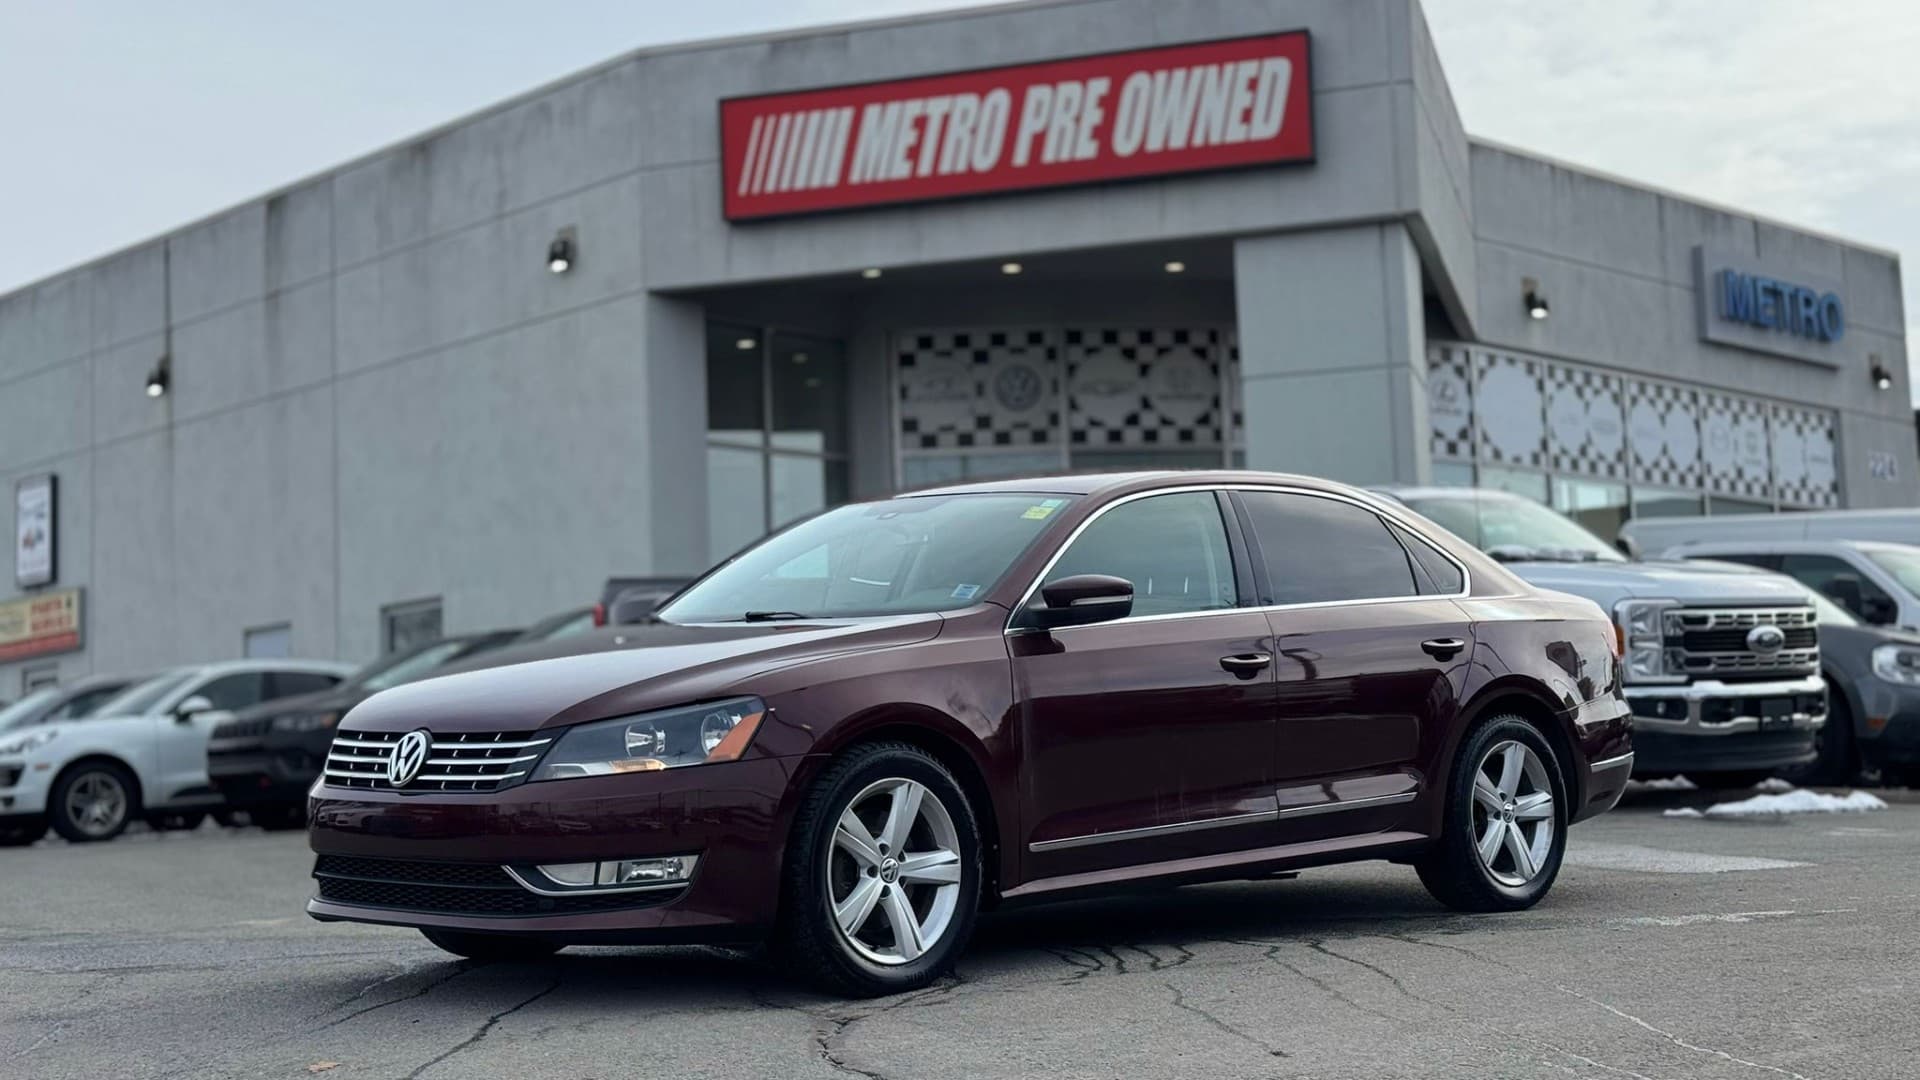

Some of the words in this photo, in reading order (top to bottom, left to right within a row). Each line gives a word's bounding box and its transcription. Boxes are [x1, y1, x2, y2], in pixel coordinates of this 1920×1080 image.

[851, 88, 1012, 184] METRO
[1012, 77, 1112, 167] PRE
[1112, 56, 1293, 157] OWNED
[1723, 269, 1844, 342] METRO
